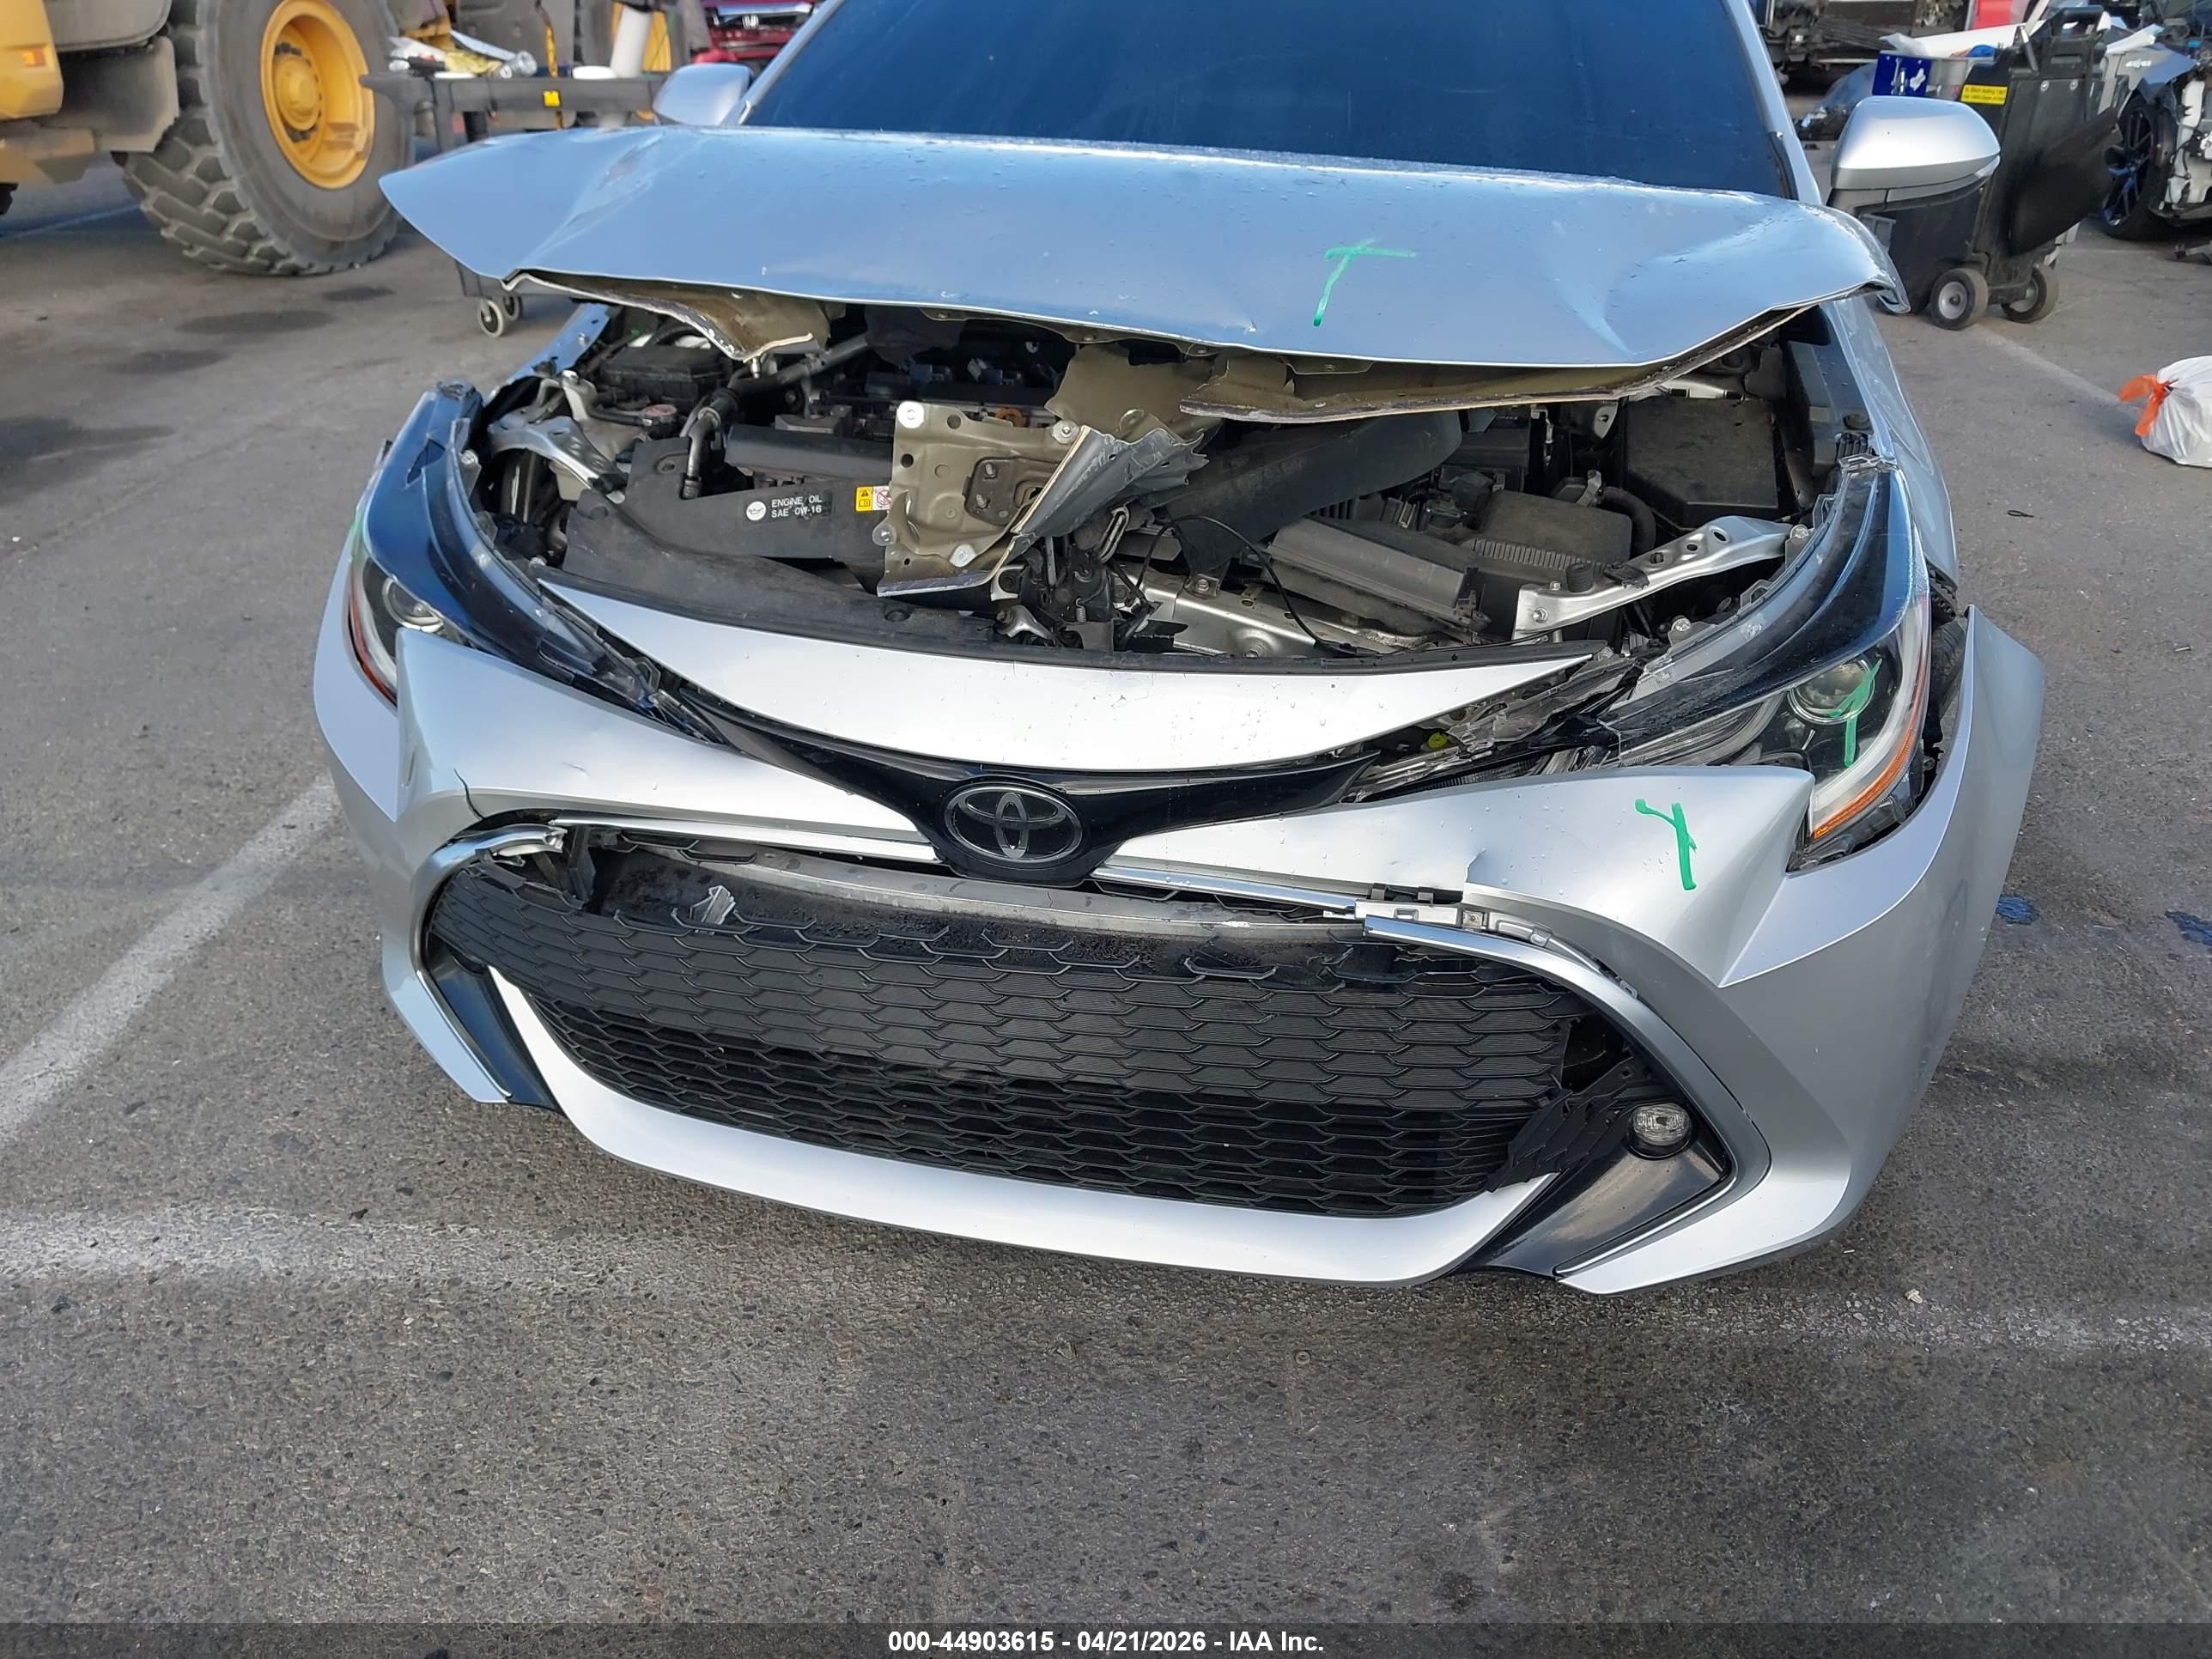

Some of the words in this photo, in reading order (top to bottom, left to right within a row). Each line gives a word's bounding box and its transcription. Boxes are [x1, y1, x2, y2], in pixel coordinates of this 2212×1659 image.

[771, 495, 803, 507] ENGINE
[809, 494, 823, 504] OIL
[771, 508, 789, 518] SAE
[794, 505, 823, 515] 0W-16
